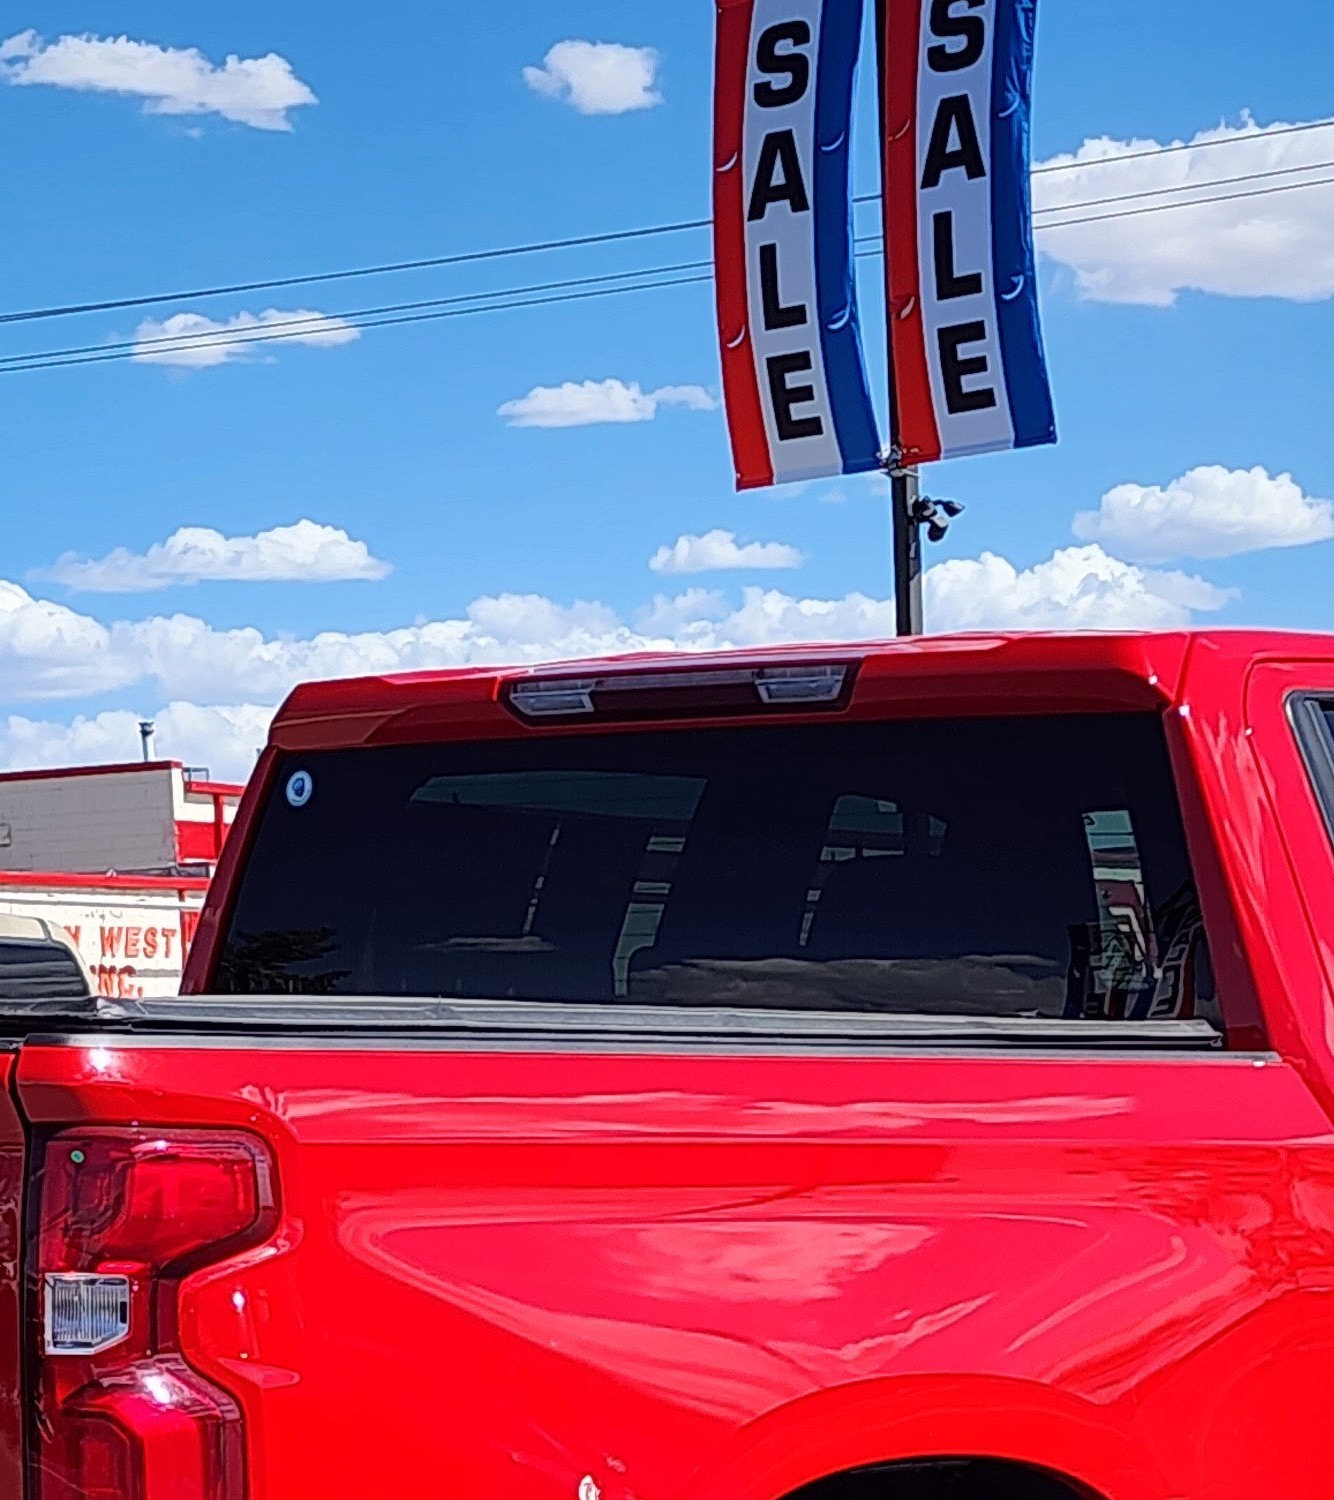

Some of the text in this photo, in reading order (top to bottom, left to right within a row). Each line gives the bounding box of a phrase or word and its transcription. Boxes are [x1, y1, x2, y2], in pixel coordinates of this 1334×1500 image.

[747, 20, 824, 441] SALE
[920, 0, 997, 416] SALE
[99, 924, 177, 959] WEST
